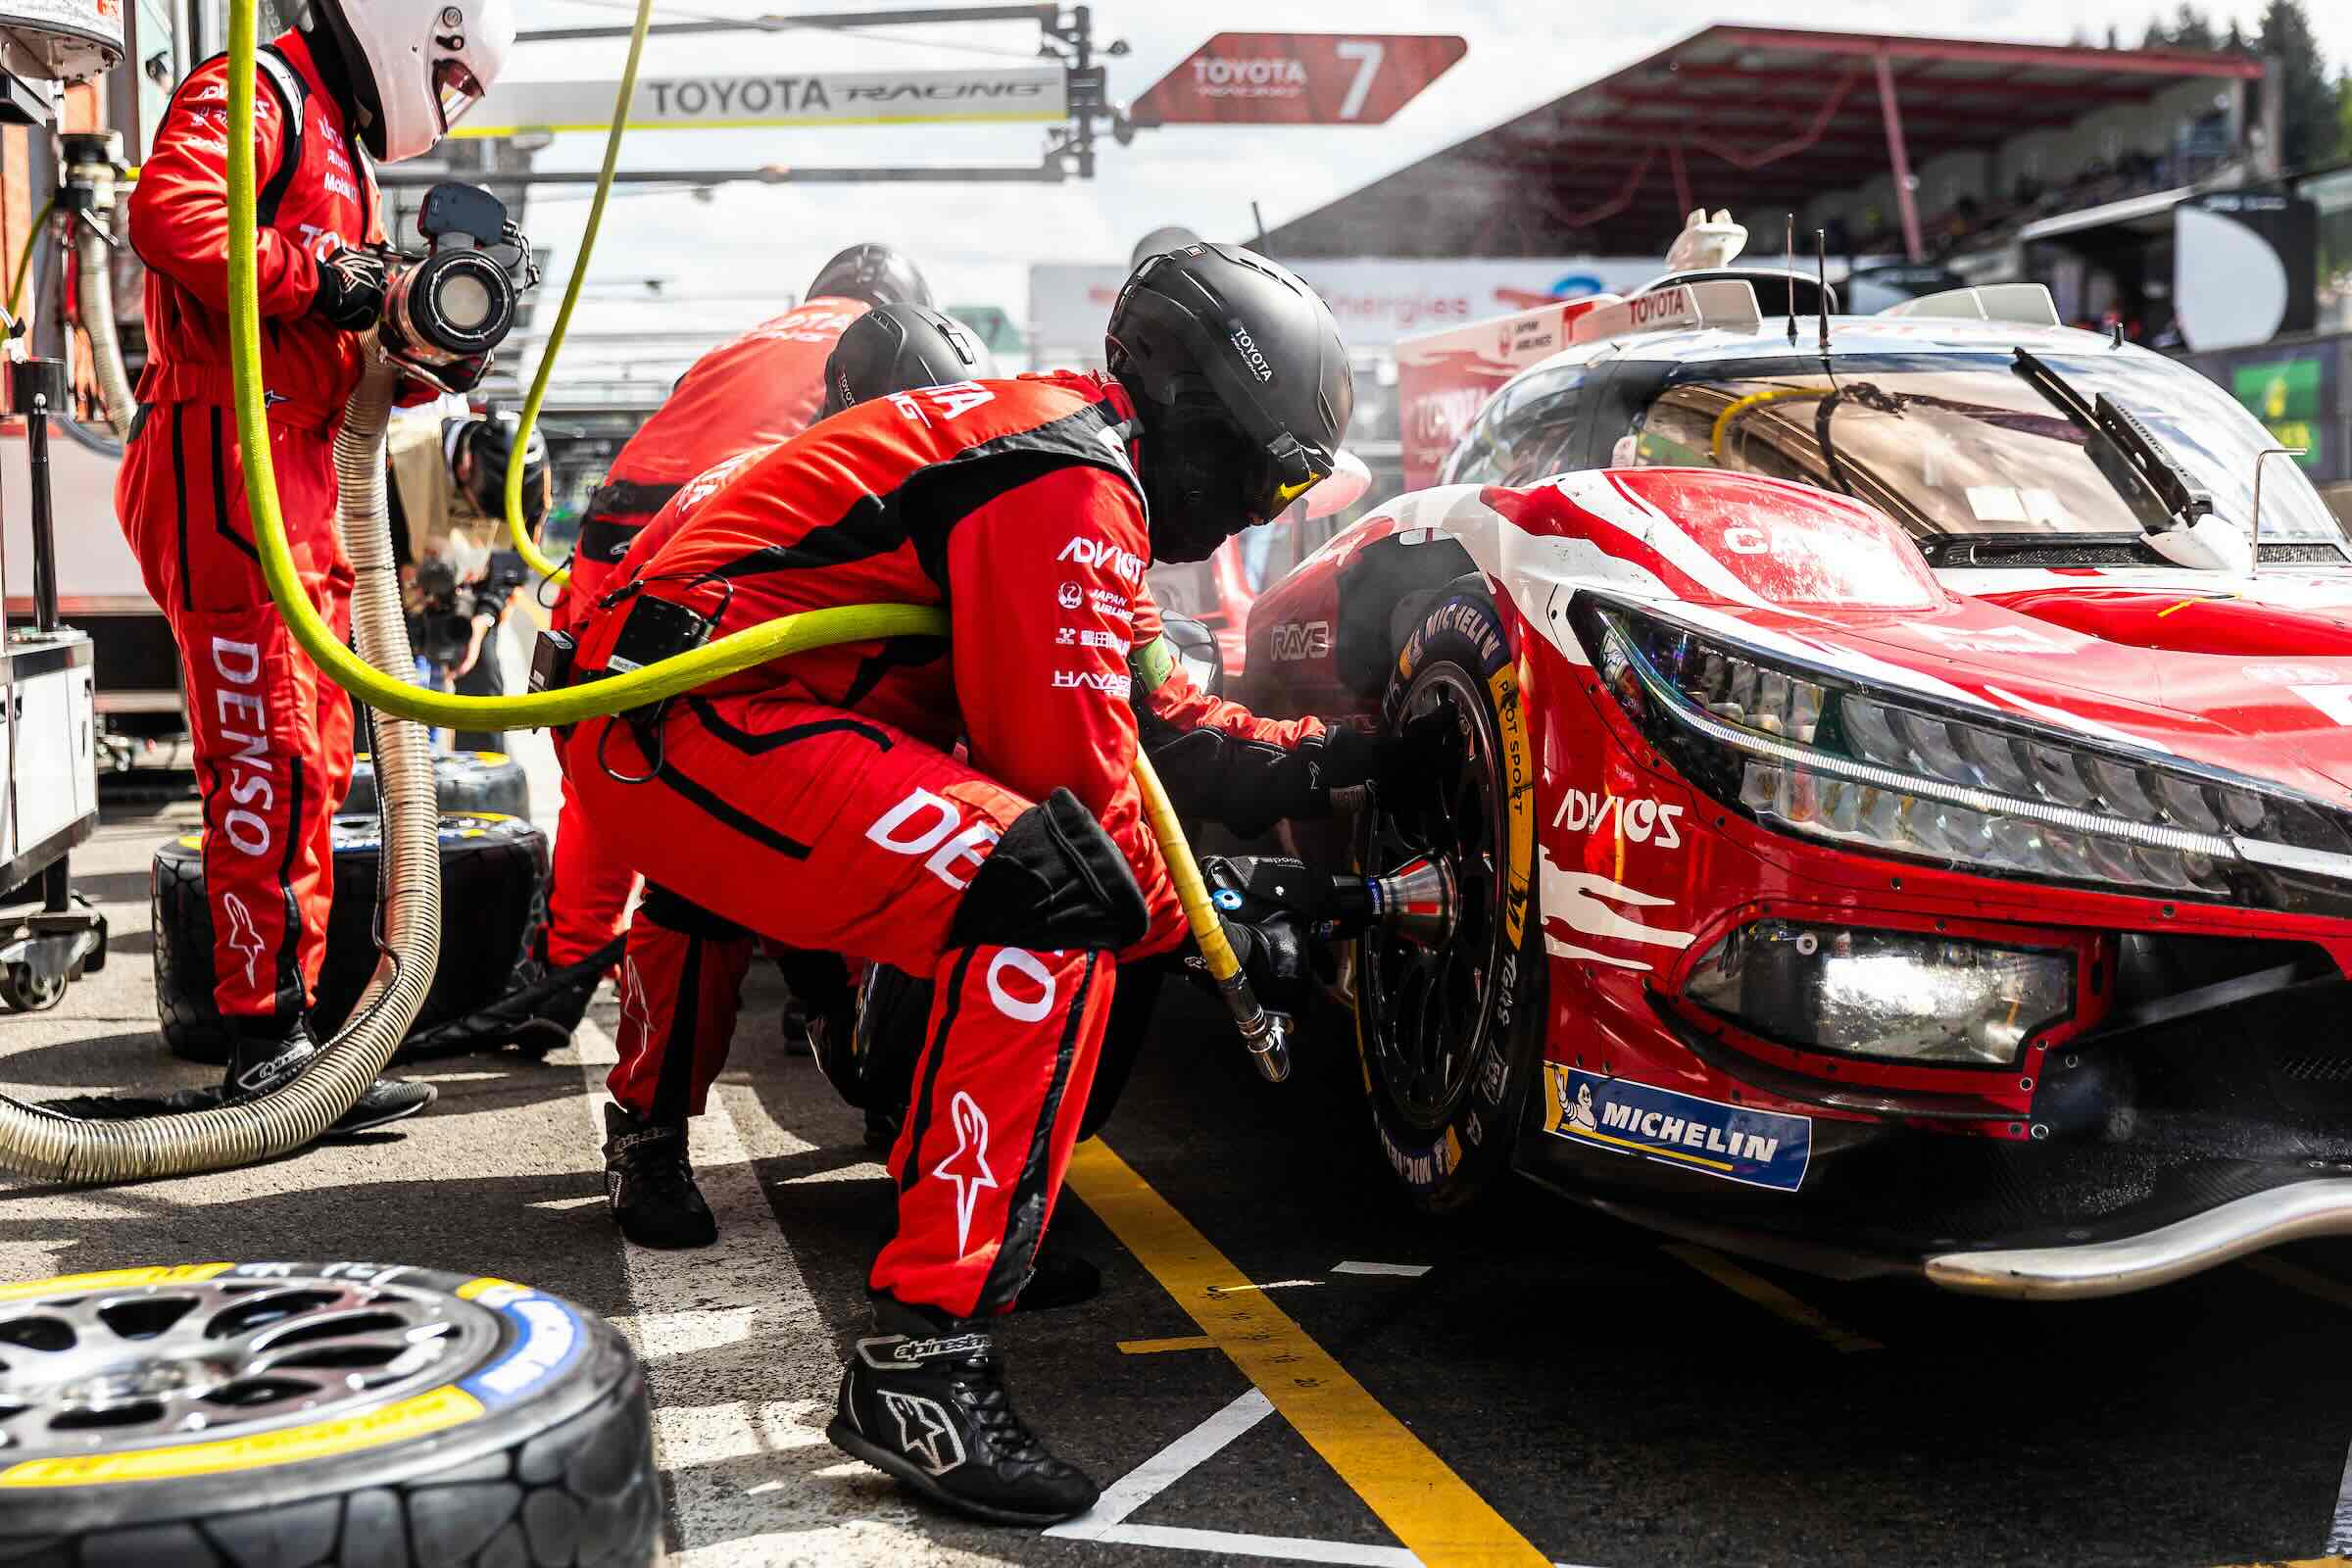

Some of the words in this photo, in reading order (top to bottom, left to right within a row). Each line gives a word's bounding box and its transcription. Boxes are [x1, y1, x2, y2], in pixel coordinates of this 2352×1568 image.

[647, 78, 831, 116] TOYOTA
[843, 79, 1059, 103] RACING
[1192, 57, 1307, 84] TOYOTA
[1336, 41, 1385, 120] 7
[1630, 289, 1686, 326] TOYOTA
[1235, 325, 1272, 381] TOYOTA
[840, 371, 857, 407] TOYOT
[1089, 588, 1128, 607] JAPAN
[1424, 603, 1501, 661] MICHELIN
[211, 636, 274, 858] DENSO
[1551, 788, 1684, 849] ADVICS
[1601, 1101, 1780, 1163] MICHELIN
